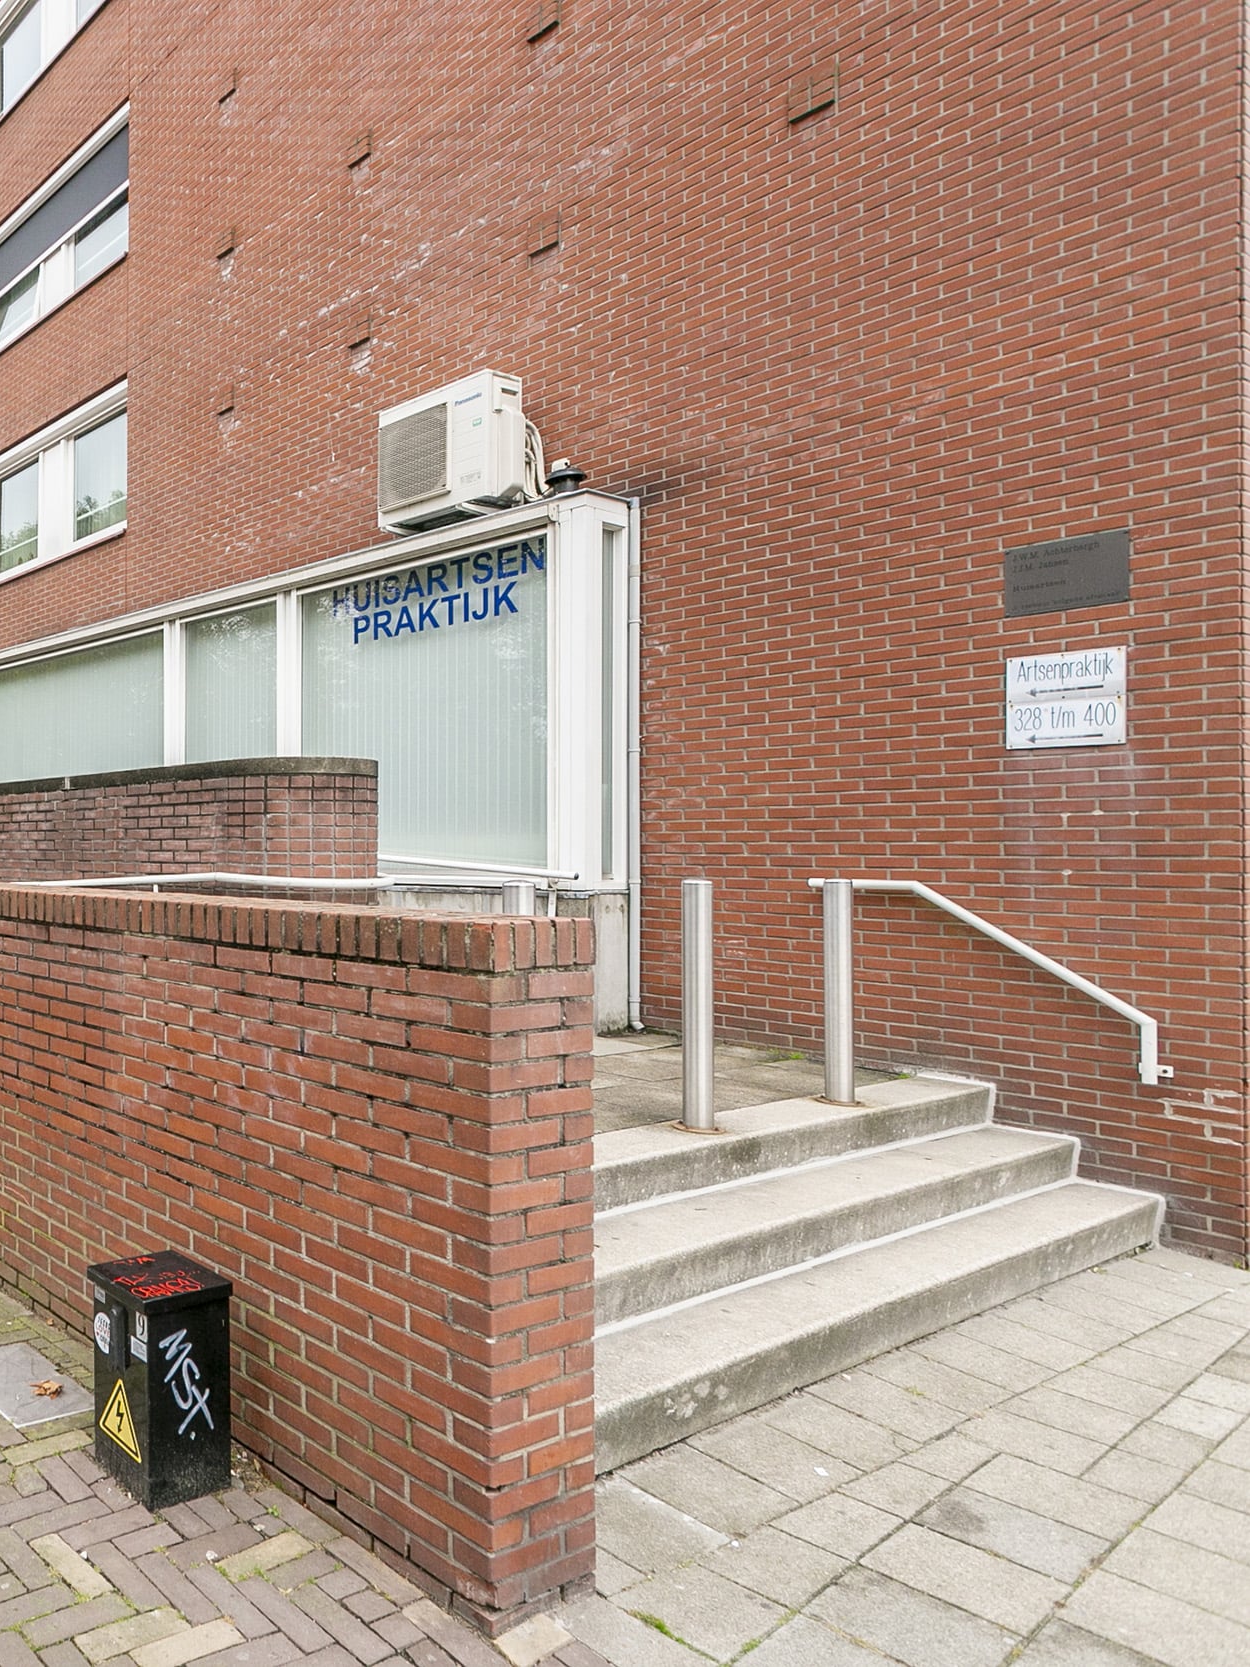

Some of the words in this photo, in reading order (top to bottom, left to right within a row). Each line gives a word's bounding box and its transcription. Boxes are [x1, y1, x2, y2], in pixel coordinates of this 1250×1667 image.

[333, 537, 545, 616] HUISARTSEN
[353, 581, 519, 645] PRAKTIJK
[1017, 652, 1113, 684] Artsenpraktijk
[1014, 706, 1042, 732] 328
[1051, 705, 1076, 728] t/m
[1083, 702, 1117, 727] 400
